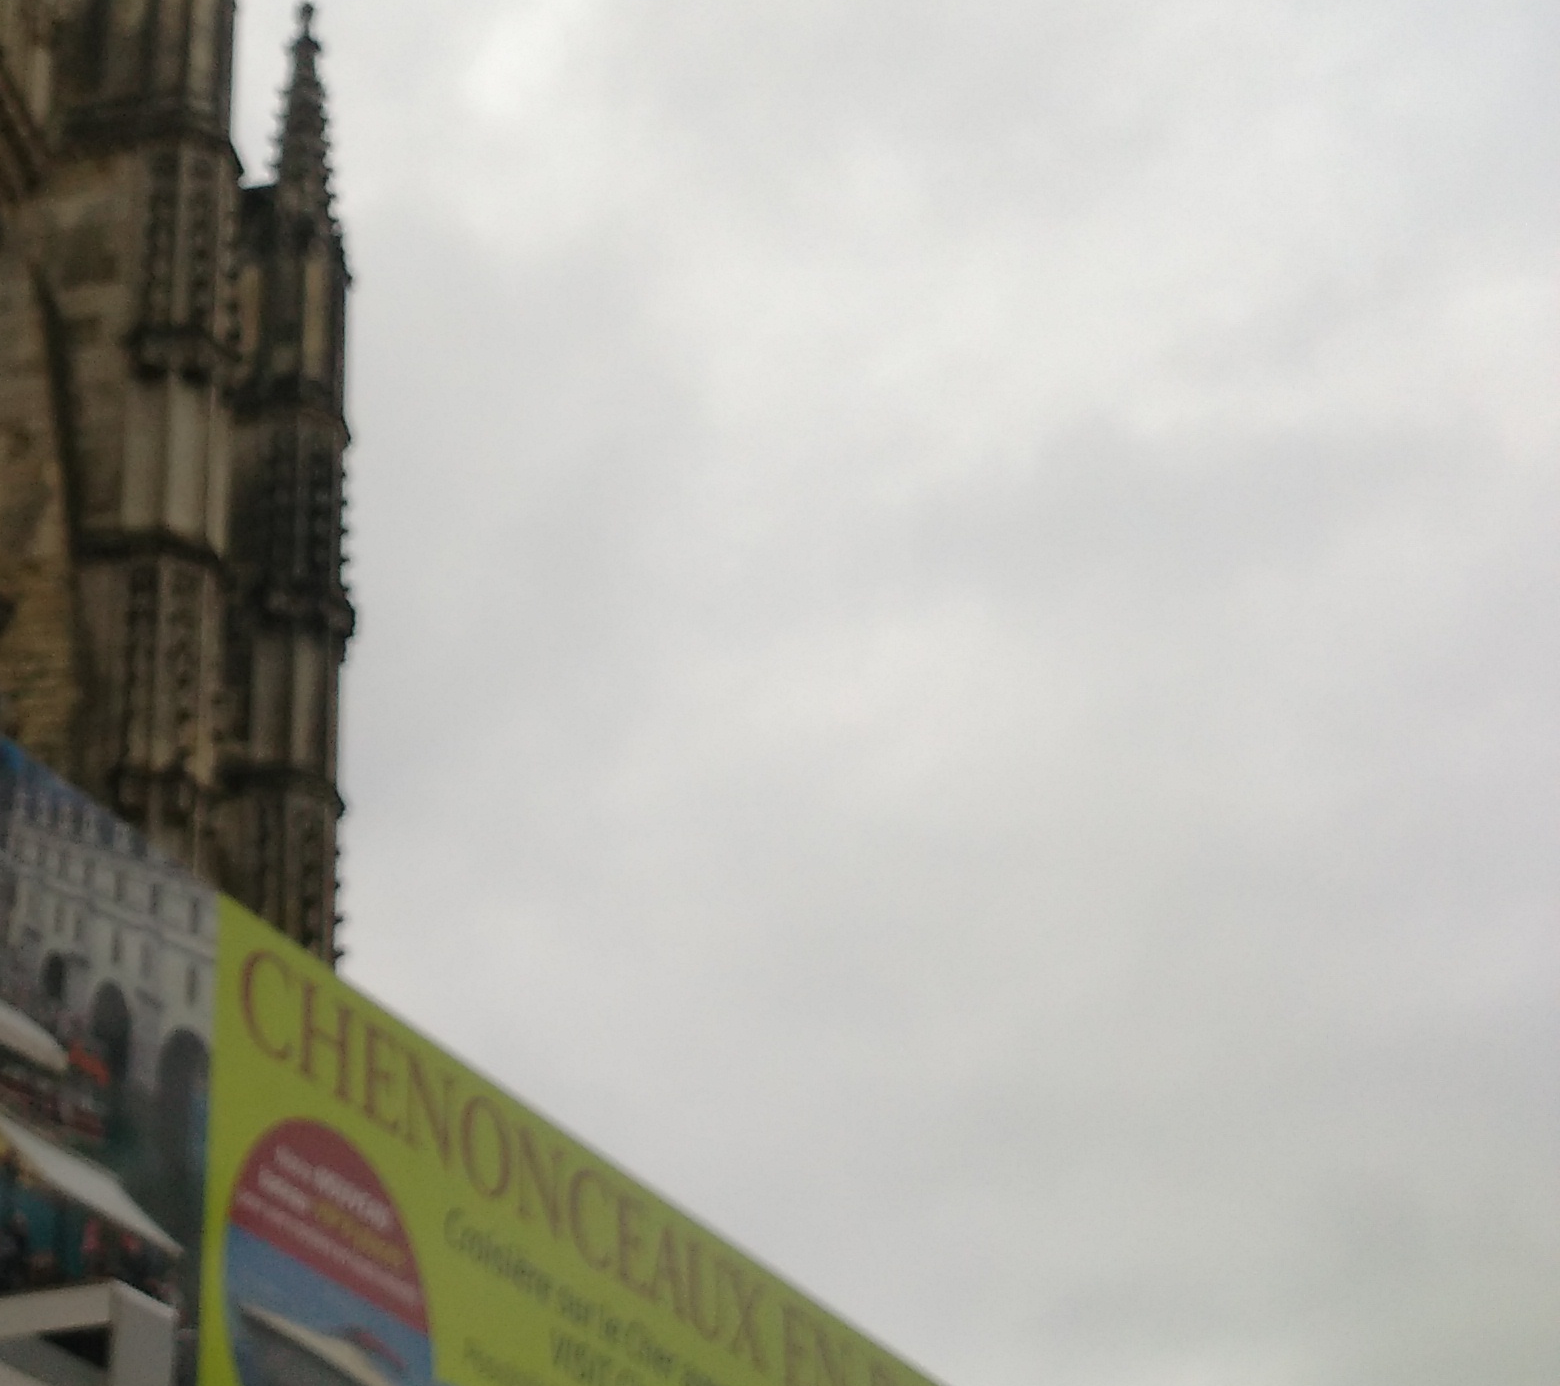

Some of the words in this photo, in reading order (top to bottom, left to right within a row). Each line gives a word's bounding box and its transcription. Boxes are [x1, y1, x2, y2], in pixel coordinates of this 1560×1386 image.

[239, 948, 769, 1374] CHENONCEAUX
[557, 1286, 592, 1328] sur
[625, 1316, 677, 1377] Cher
